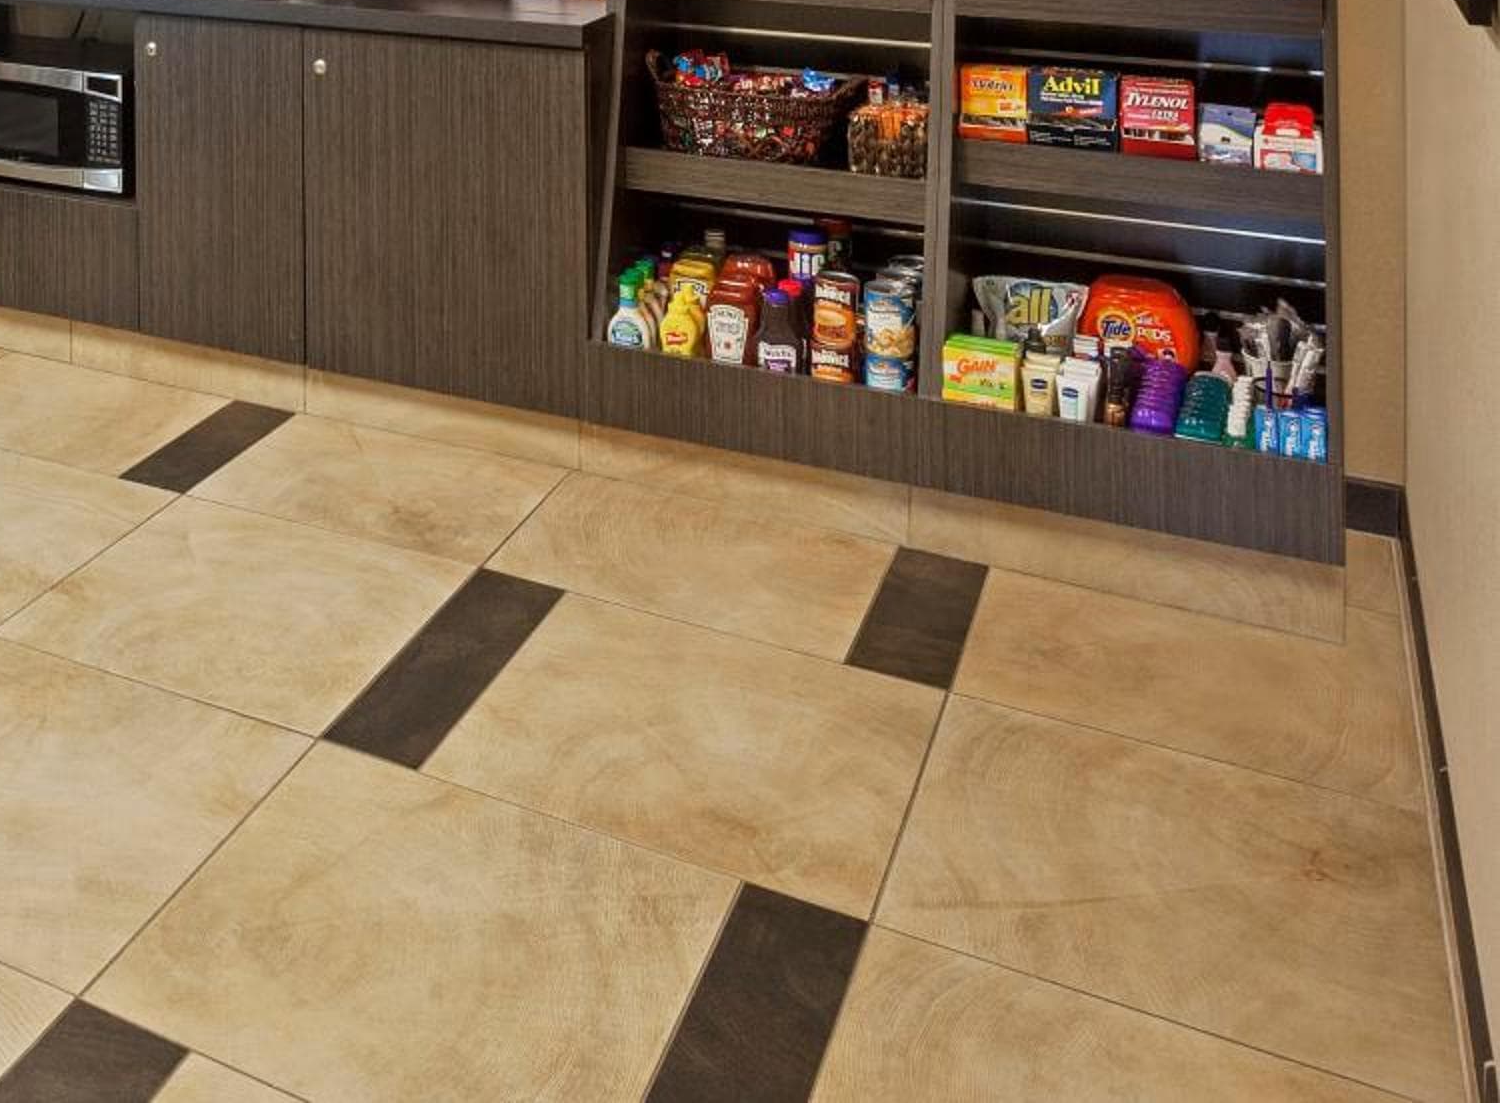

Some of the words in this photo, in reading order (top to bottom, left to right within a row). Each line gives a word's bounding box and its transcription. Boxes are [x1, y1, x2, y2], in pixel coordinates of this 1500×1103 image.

[1043, 75, 1101, 95] Advil
[1125, 91, 1190, 110] TYLENOL
[1006, 287, 1052, 325] all
[1102, 319, 1131, 338] Tide
